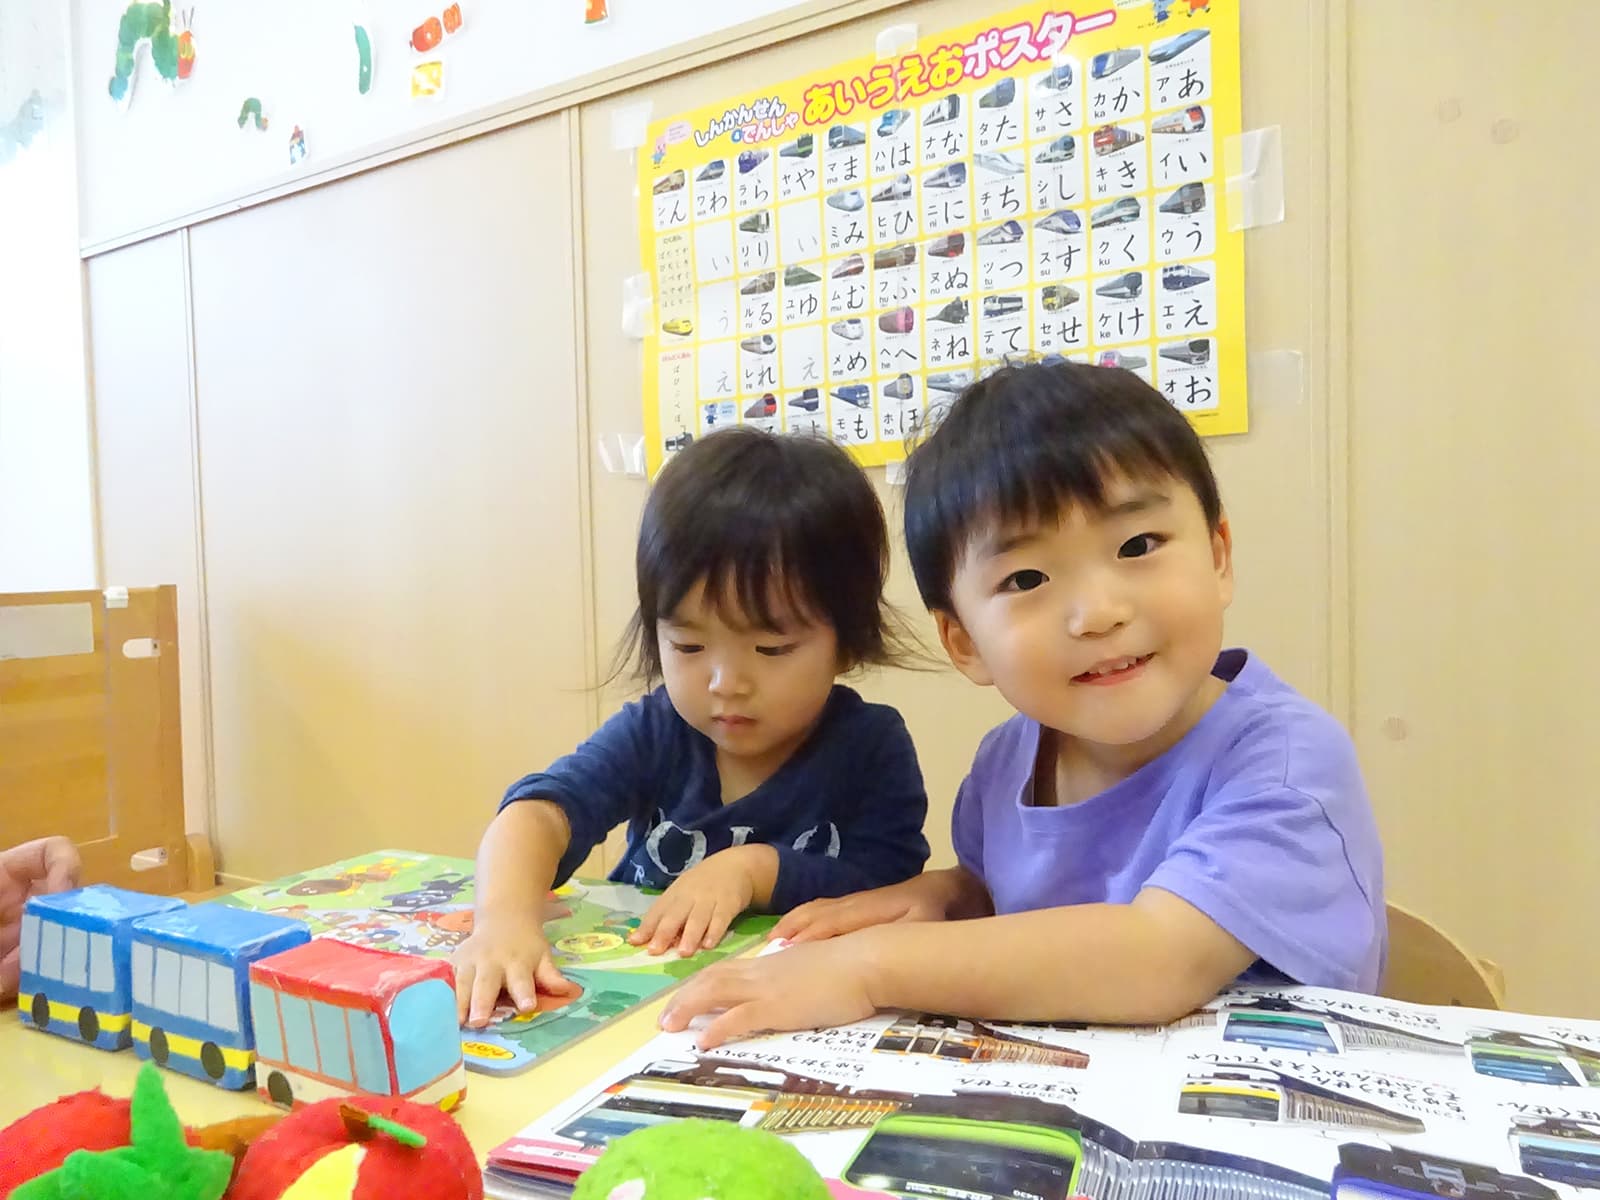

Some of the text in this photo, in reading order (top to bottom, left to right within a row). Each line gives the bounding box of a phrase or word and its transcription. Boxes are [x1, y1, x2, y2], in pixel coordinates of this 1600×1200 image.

[803, 9, 1117, 126] あいうえおポスター
[1157, 77, 1170, 91] ア
[1178, 69, 1204, 99] あ
[1094, 93, 1106, 107] カ
[1112, 86, 1141, 113] か
[694, 96, 786, 147] しんかんせん
[1035, 107, 1047, 121] サ
[1055, 101, 1073, 127] さ
[741, 112, 800, 144] でんしゃ
[980, 123, 989, 135] タ
[995, 115, 1017, 142] た
[925, 136, 936, 148] ナ
[941, 131, 964, 156] な
[875, 151, 886, 160] ハ
[890, 142, 912, 168] は
[1159, 152, 1170, 167] イ
[1179, 151, 1207, 172] い
[828, 162, 837, 173] マ
[843, 156, 858, 181] ま
[1096, 167, 1108, 180] キ
[1118, 161, 1138, 188] き
[754, 179, 769, 201] ら
[796, 168, 815, 190] や
[1037, 180, 1048, 194] シ
[1058, 174, 1077, 200] し
[709, 191, 727, 213] わ
[981, 190, 992, 205] チ
[999, 185, 1020, 213] ち
[670, 199, 688, 224] ん
[878, 216, 886, 227] ヒ
[927, 205, 938, 216] ニ
[944, 199, 965, 224] に
[844, 222, 864, 244] み
[894, 210, 913, 234] ひ
[1099, 240, 1110, 255] ク
[1162, 229, 1175, 244] ウ
[1186, 222, 1202, 252] う
[758, 241, 769, 263] り
[1040, 251, 1051, 264] ス
[1056, 245, 1081, 273] す
[1123, 234, 1135, 262] く
[712, 256, 730, 270] い
[983, 262, 994, 275] ツ
[1000, 260, 1023, 278] つ
[880, 281, 888, 292] フ
[893, 277, 917, 300] ふ
[931, 272, 940, 283] ヌ
[944, 267, 968, 290] ぬ
[800, 293, 818, 317] ゆ
[832, 290, 840, 301] ム
[847, 285, 865, 310] む
[759, 303, 772, 325] る
[1099, 313, 1112, 327] ケ
[1118, 307, 1145, 335] け
[1162, 305, 1175, 317] エ
[1184, 299, 1209, 328] え
[984, 331, 995, 344] テ
[1001, 326, 1022, 351] て
[1040, 323, 1051, 335] セ
[1057, 316, 1083, 344] せ
[931, 339, 941, 351] ネ
[946, 335, 970, 361] ね
[802, 357, 819, 381] え
[834, 356, 841, 366] メ
[848, 352, 867, 372] め
[716, 372, 732, 393] え
[758, 366, 776, 386] れ
[1165, 380, 1177, 394] オ
[1185, 375, 1212, 403] お
[836, 419, 845, 430] モ
[854, 415, 868, 440] も
[884, 414, 894, 425] ホ
[900, 409, 918, 434] ほ
[686, 1045, 865, 1073] ちゅうおうせんかいく
[955, 1078, 1080, 1096] やまのてせん
